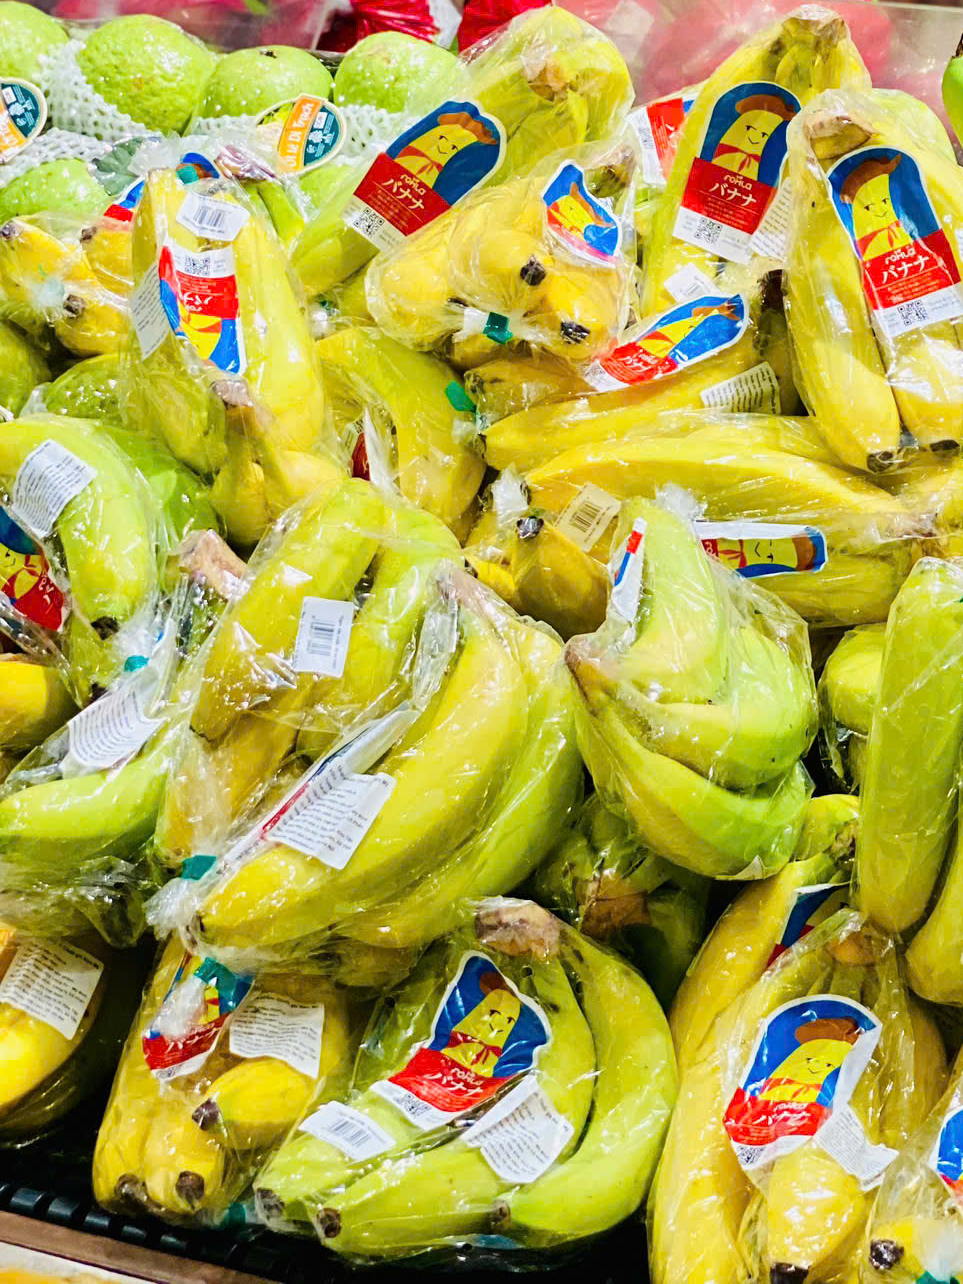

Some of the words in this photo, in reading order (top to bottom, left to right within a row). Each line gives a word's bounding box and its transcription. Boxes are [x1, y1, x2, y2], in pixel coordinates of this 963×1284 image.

[382, 178, 425, 209] バナナ
[709, 182, 757, 206] バナナ
[883, 255, 930, 284] バナナ
[424, 1072, 483, 1097] バナナ
